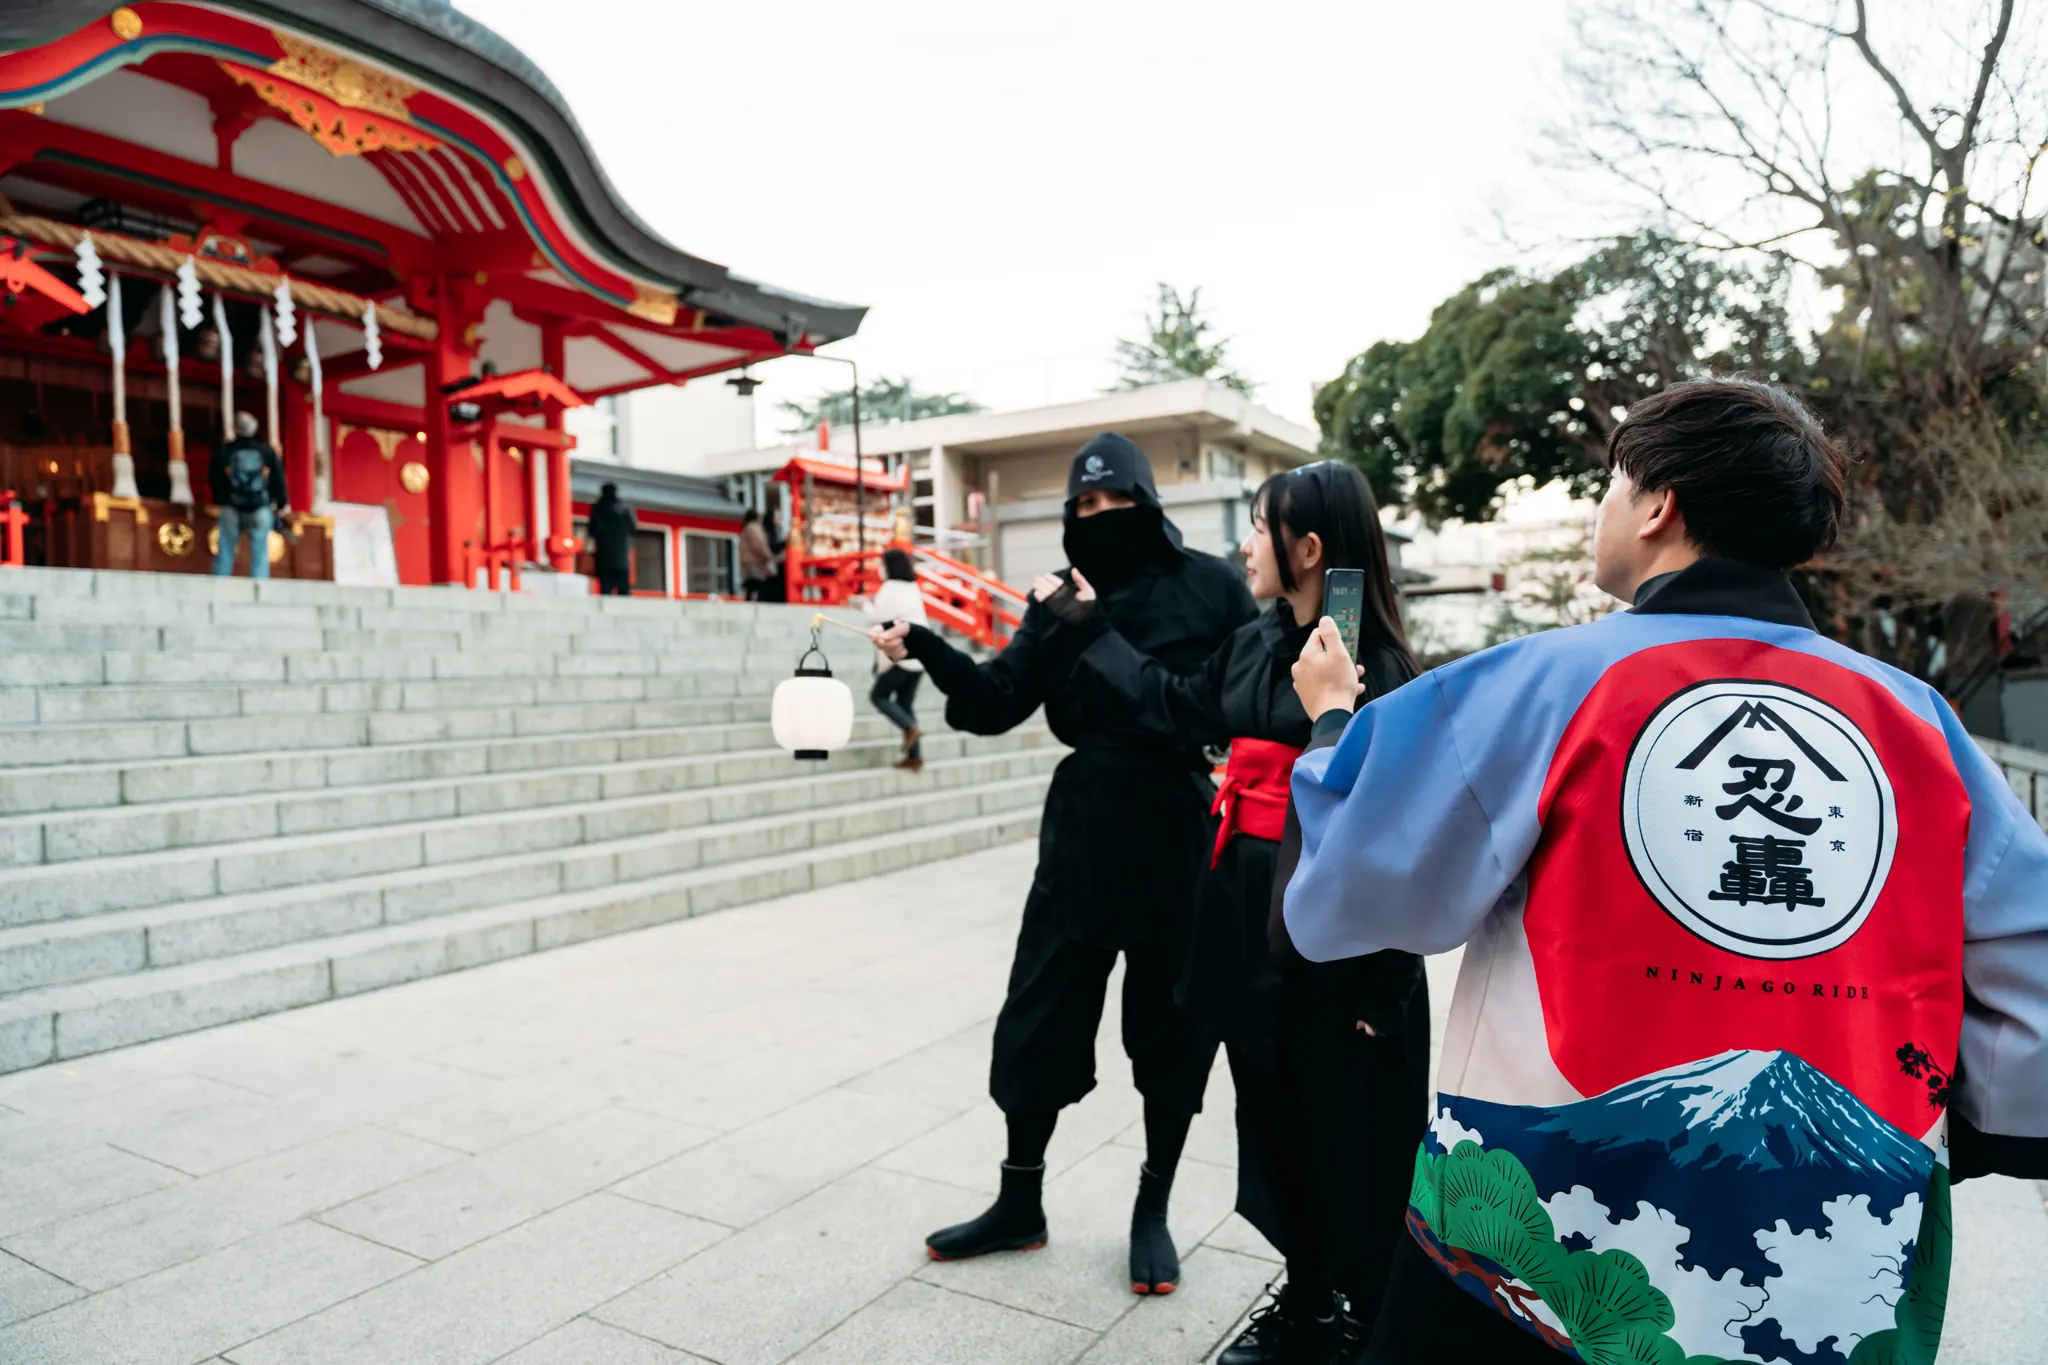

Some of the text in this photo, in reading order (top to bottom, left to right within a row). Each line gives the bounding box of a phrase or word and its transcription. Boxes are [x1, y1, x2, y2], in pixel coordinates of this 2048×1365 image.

[1684, 795, 1704, 842] 新宿
[1828, 806, 1846, 852] 東京
[1646, 966, 1868, 999] NINJA GO RIDE
